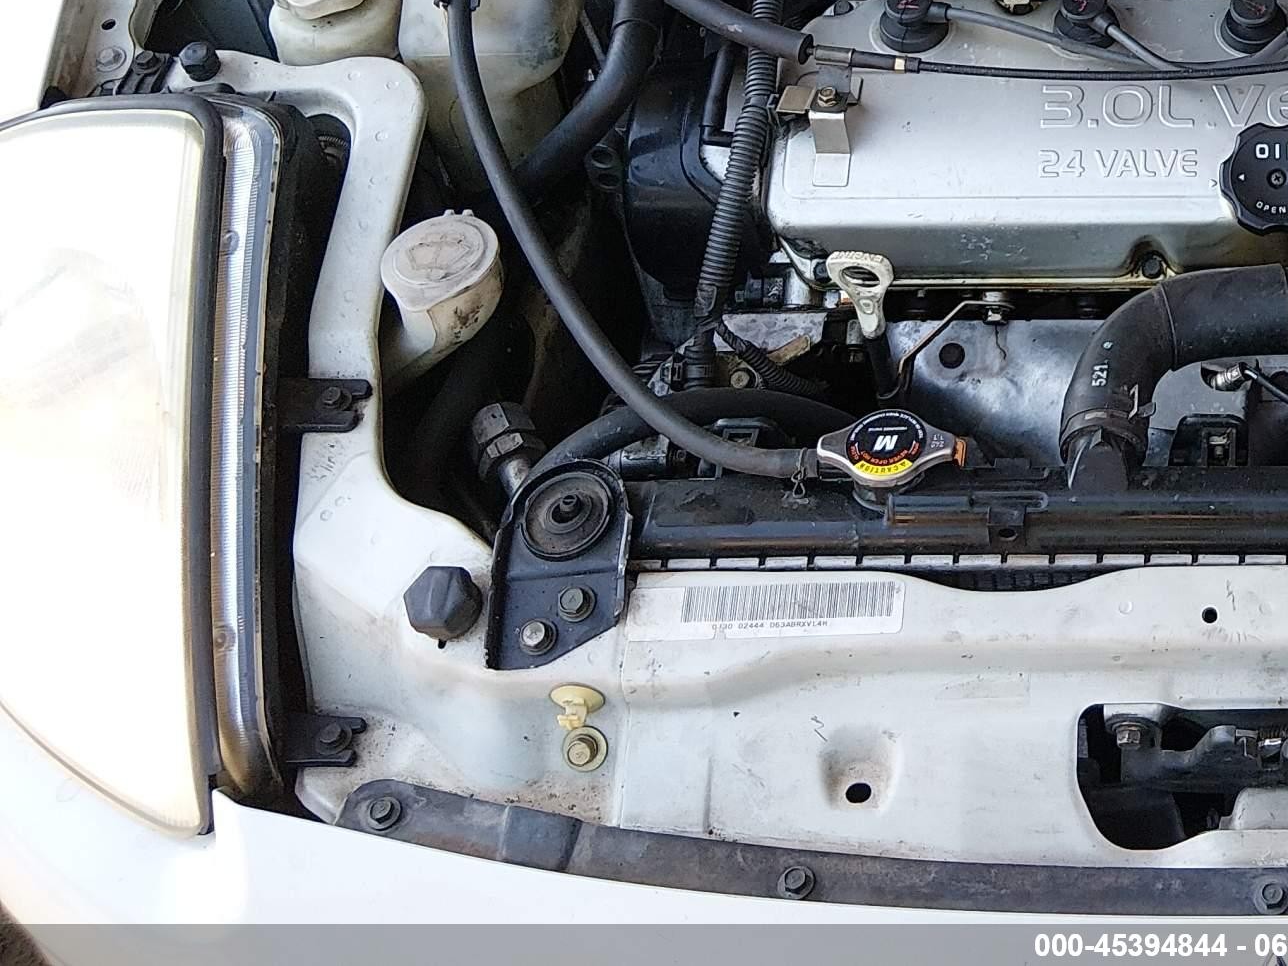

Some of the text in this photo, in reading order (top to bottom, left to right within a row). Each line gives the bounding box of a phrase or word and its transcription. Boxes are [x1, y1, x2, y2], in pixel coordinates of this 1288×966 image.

[1038, 149, 1199, 178] 24 VALVE
[1255, 200, 1287, 214] OPEN
[873, 435, 899, 451] M
[870, 457, 888, 465] OPEN
[889, 449, 908, 464] NEVER
[858, 462, 899, 474] CAUTION
